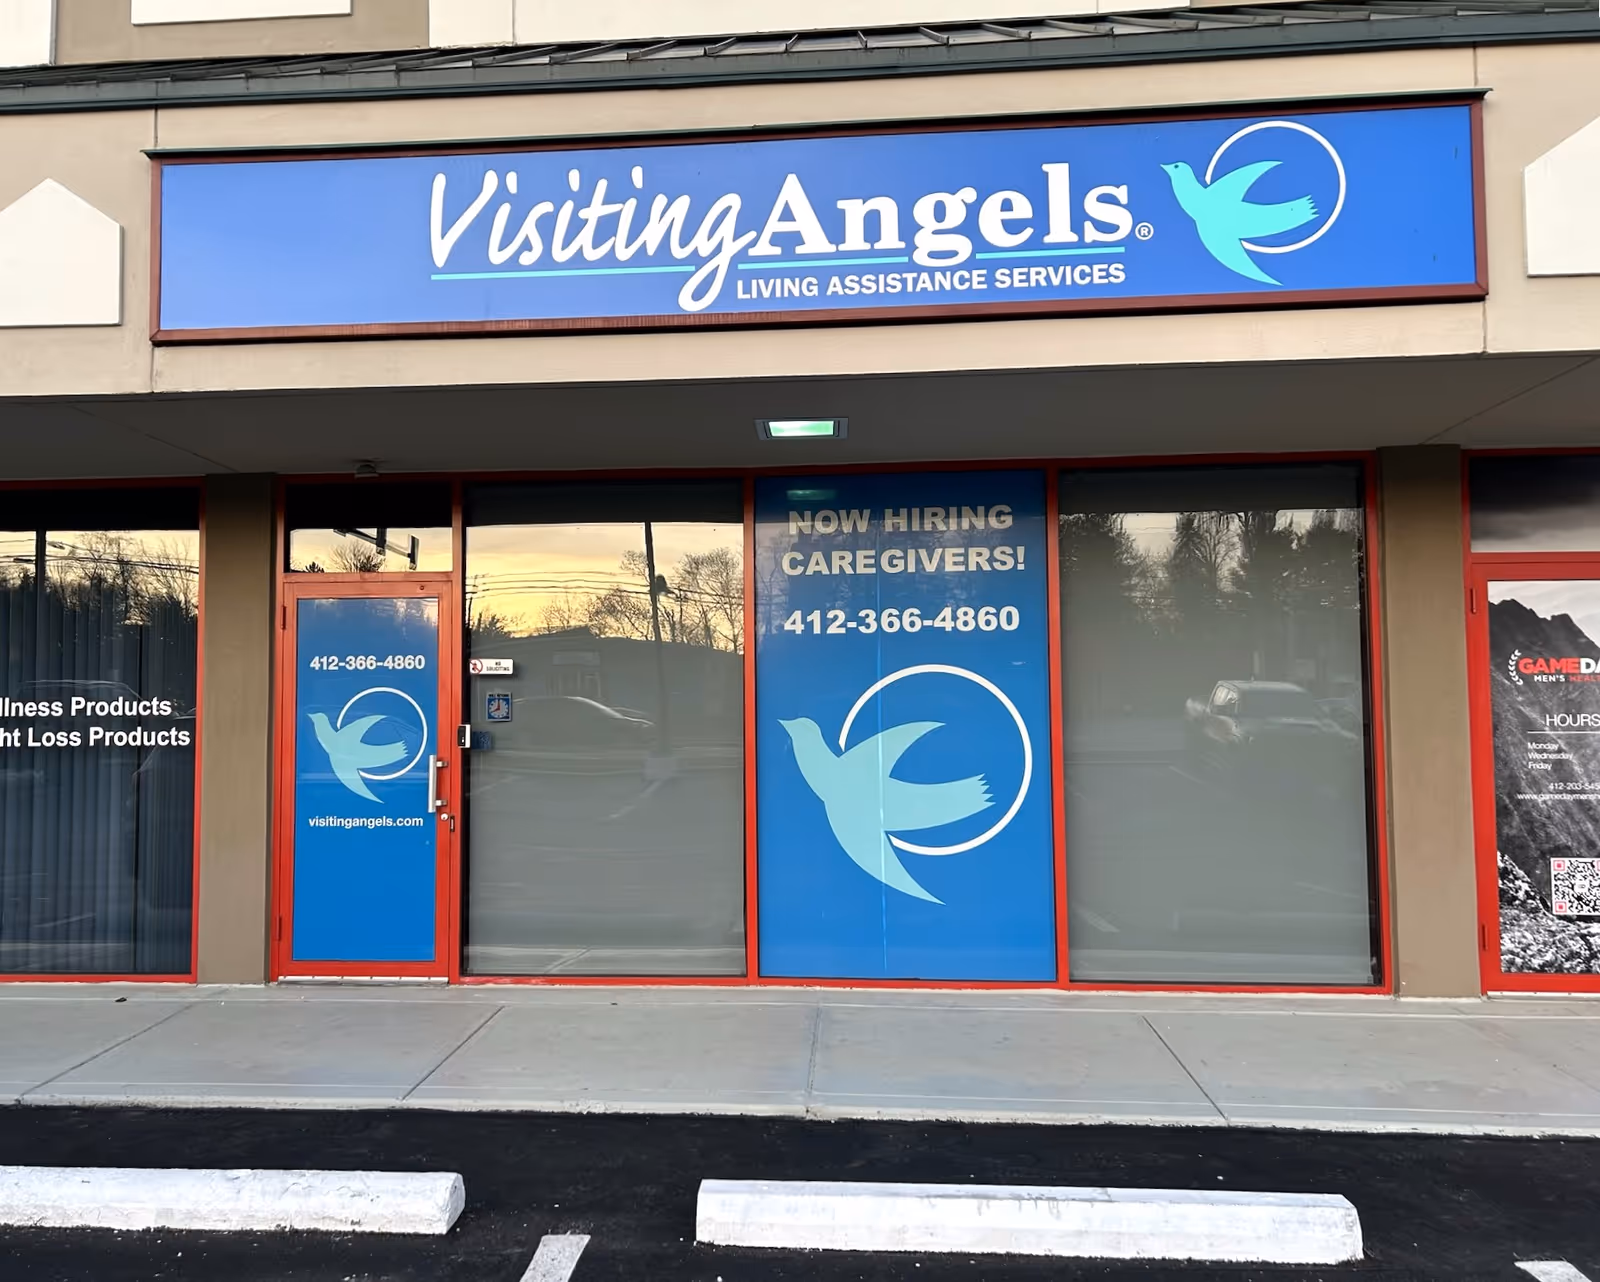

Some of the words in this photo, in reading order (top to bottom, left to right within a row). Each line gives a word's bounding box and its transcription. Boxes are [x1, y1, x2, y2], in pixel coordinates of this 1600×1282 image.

[429, 165, 757, 312] Visiting
[736, 276, 819, 299] LIVING
[826, 269, 988, 296] ASSISTANCE
[994, 263, 1126, 289] SERVICES
[788, 508, 871, 535] NOW
[884, 504, 1014, 532] HIRING
[781, 545, 1026, 576] CAREGIVERS!
[783, 605, 1020, 635] 412-366-4860
[309, 654, 426, 671] 412-366-4860
[1534, 674, 1566, 683] MEN'S
[70, 696, 172, 717] Products
[1545, 713, 1600, 727] HOURS
[27, 726, 82, 747] Loss
[89, 726, 191, 747] Products
[1527, 742, 1559, 751] Monday
[1527, 752, 1573, 760] Wednesday
[1528, 761, 1552, 770] Friday
[308, 815, 424, 829] visitingangels.com
